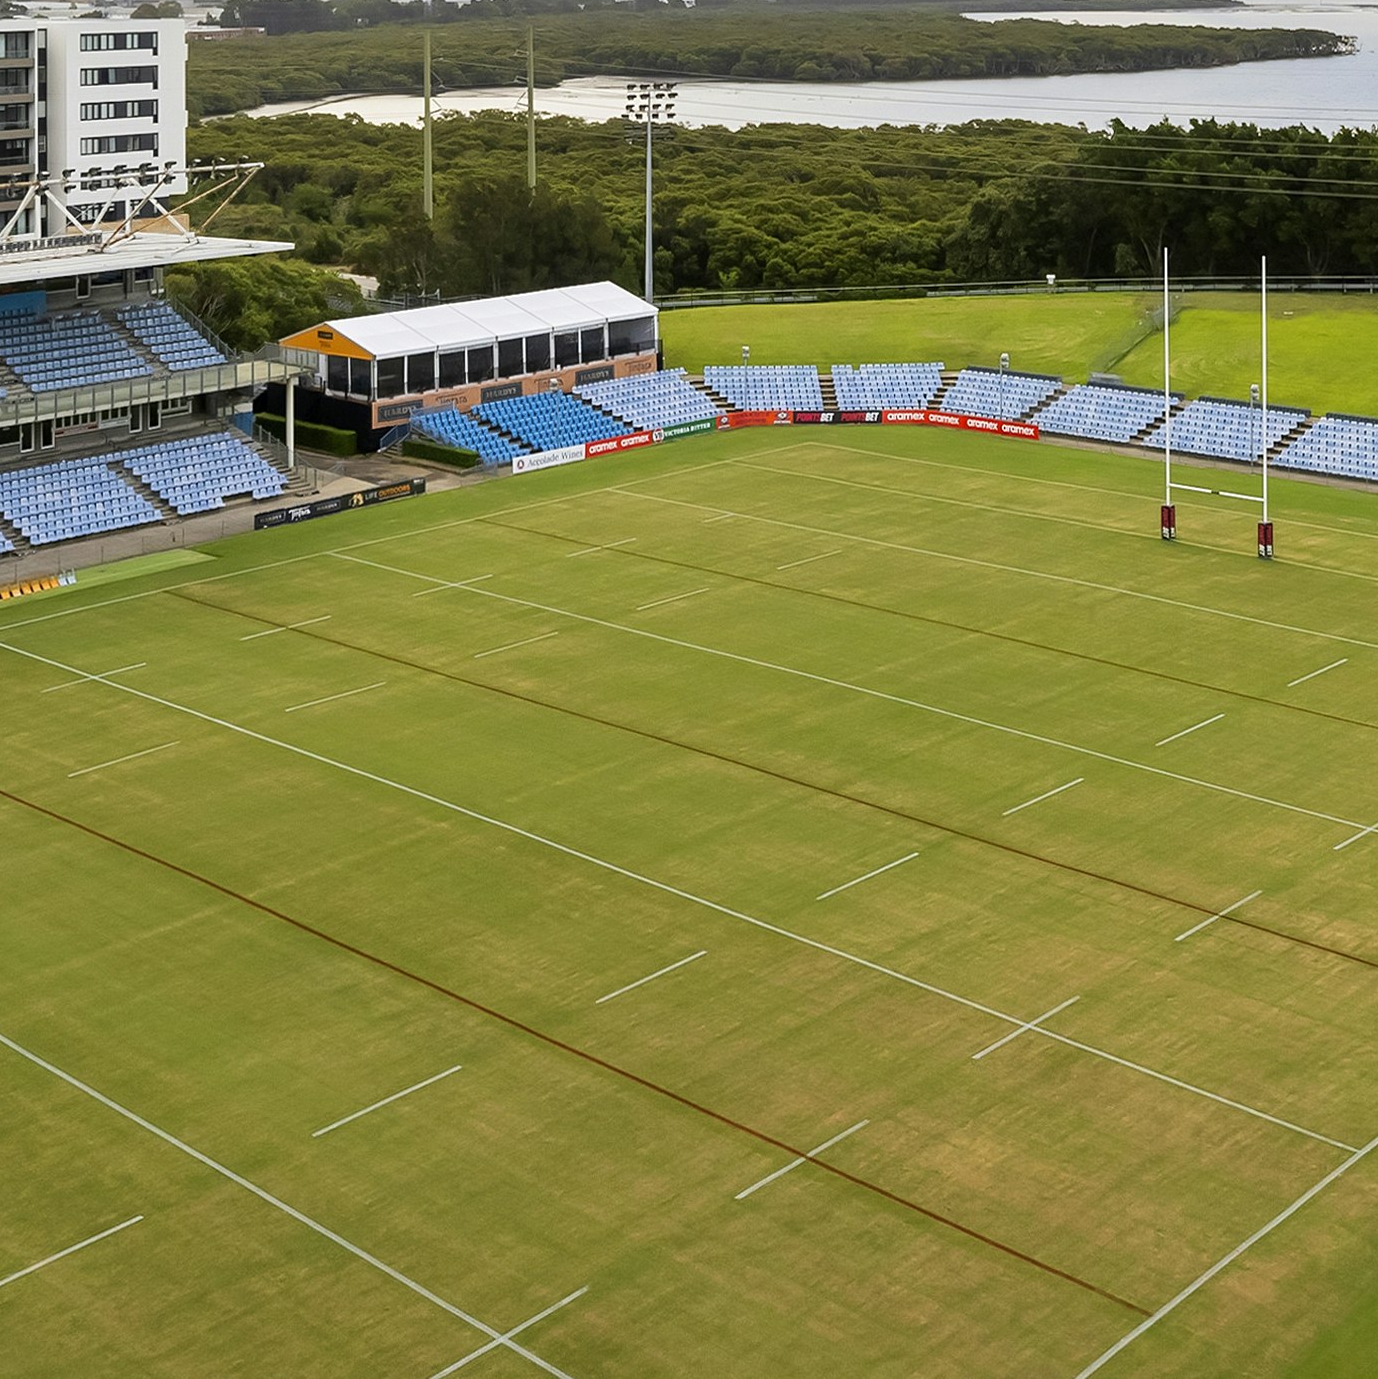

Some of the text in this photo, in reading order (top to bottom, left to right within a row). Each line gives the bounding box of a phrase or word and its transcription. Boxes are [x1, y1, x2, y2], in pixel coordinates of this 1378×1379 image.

[887, 411, 1035, 436] aramex aramex aramex aramex
[589, 434, 650, 454] aramex aramex
